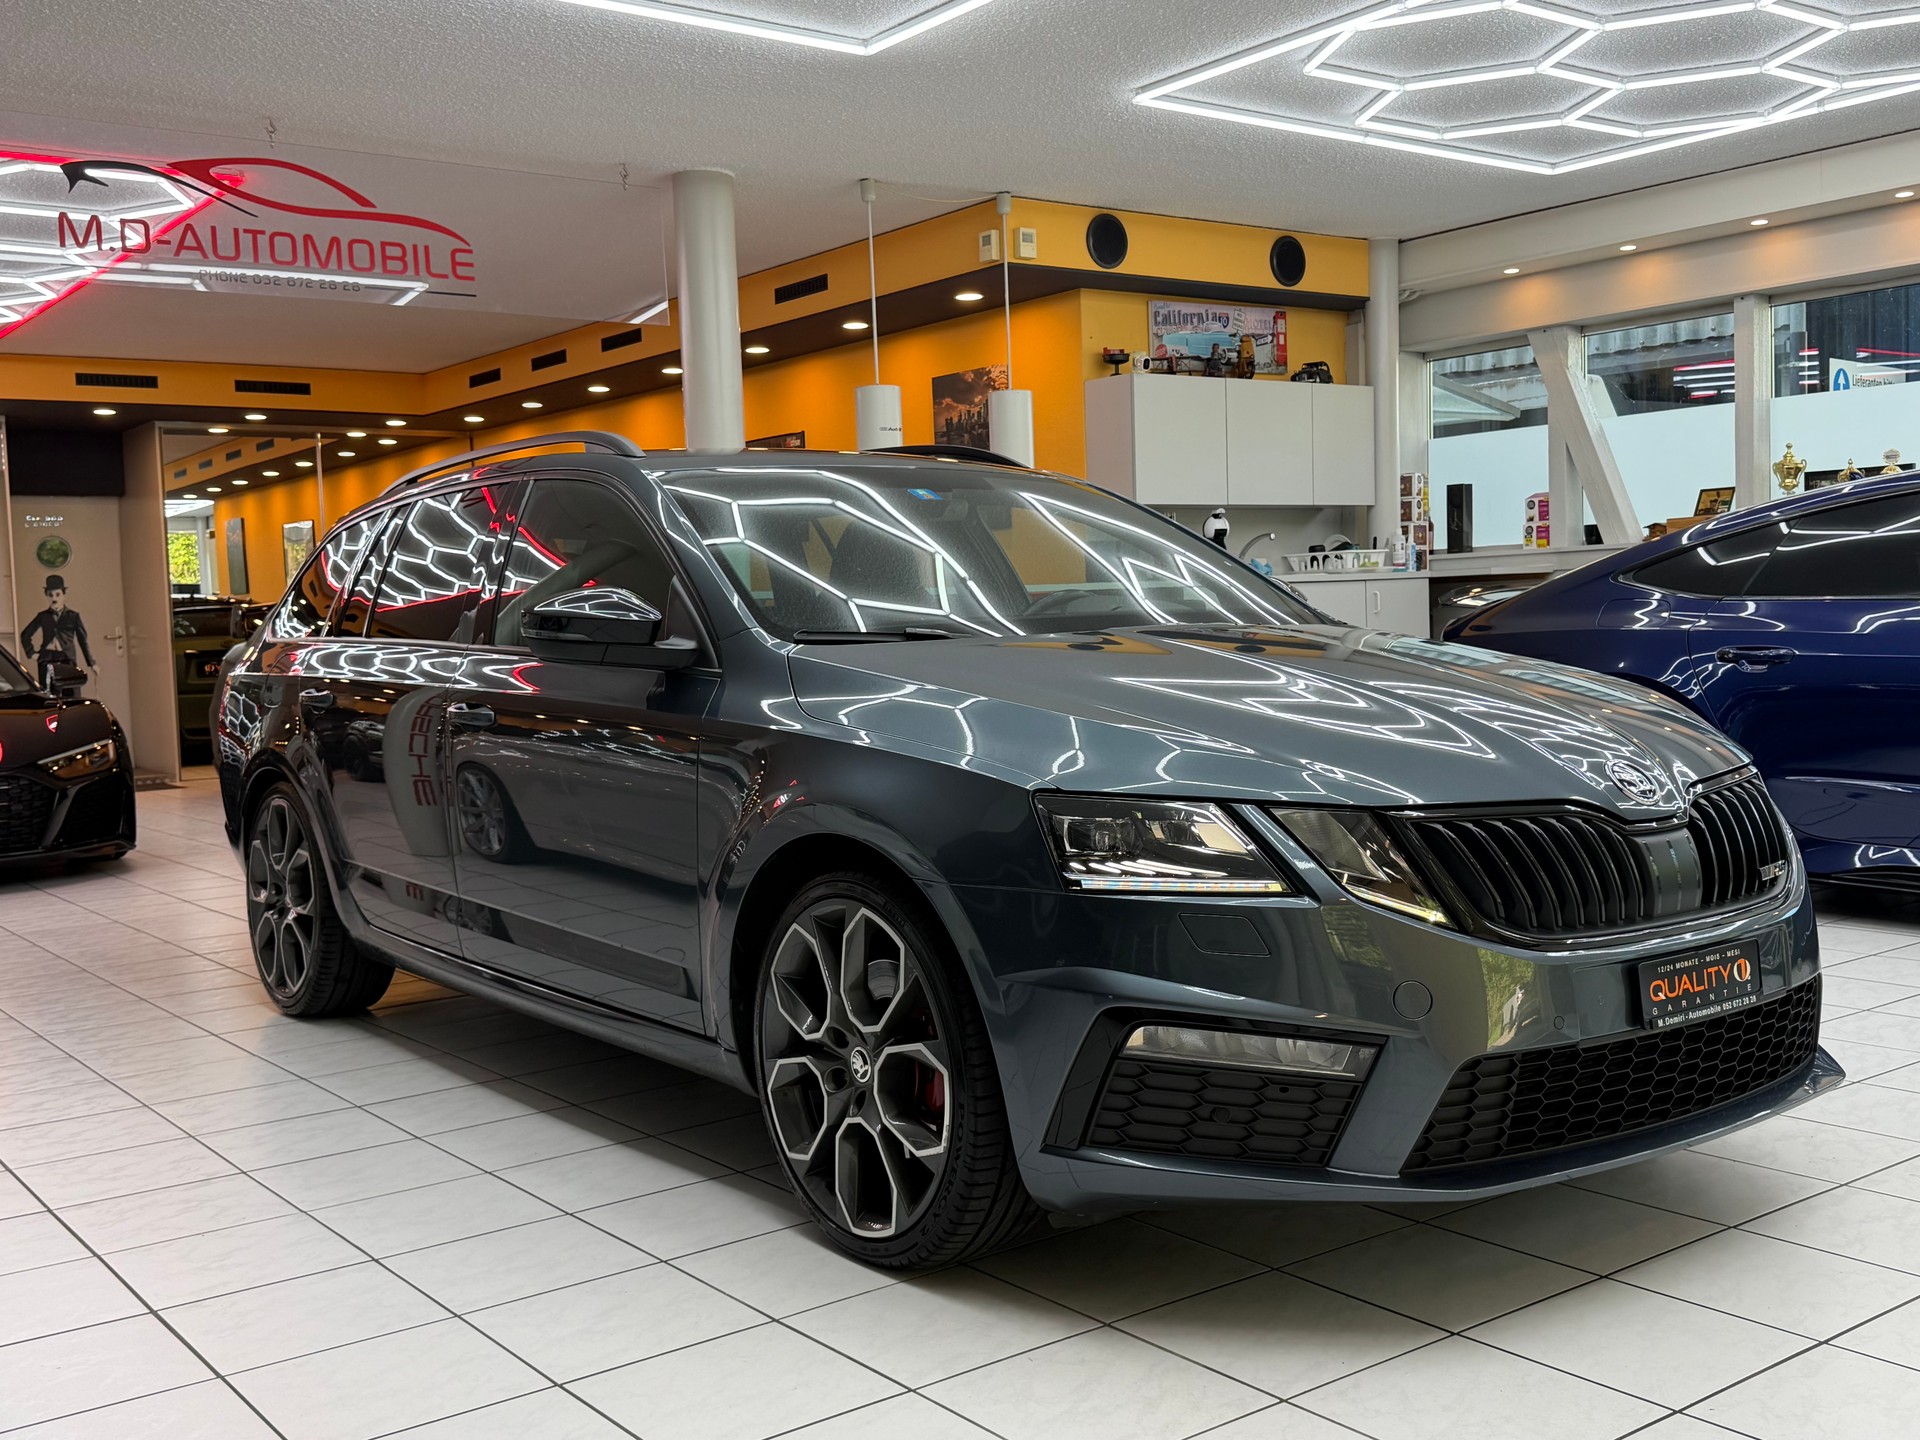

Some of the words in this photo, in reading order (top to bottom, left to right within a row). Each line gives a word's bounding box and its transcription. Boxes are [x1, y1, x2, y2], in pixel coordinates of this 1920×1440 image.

[199, 269, 248, 284] PHONE
[1657, 964, 1674, 973] 12/24
[1675, 958, 1699, 969] MONATE
[1705, 953, 1720, 962] MOIS
[1726, 948, 1741, 958] MESI
[1650, 963, 1732, 1002] QUALITY
[1652, 983, 1752, 1016] GARANTIE
